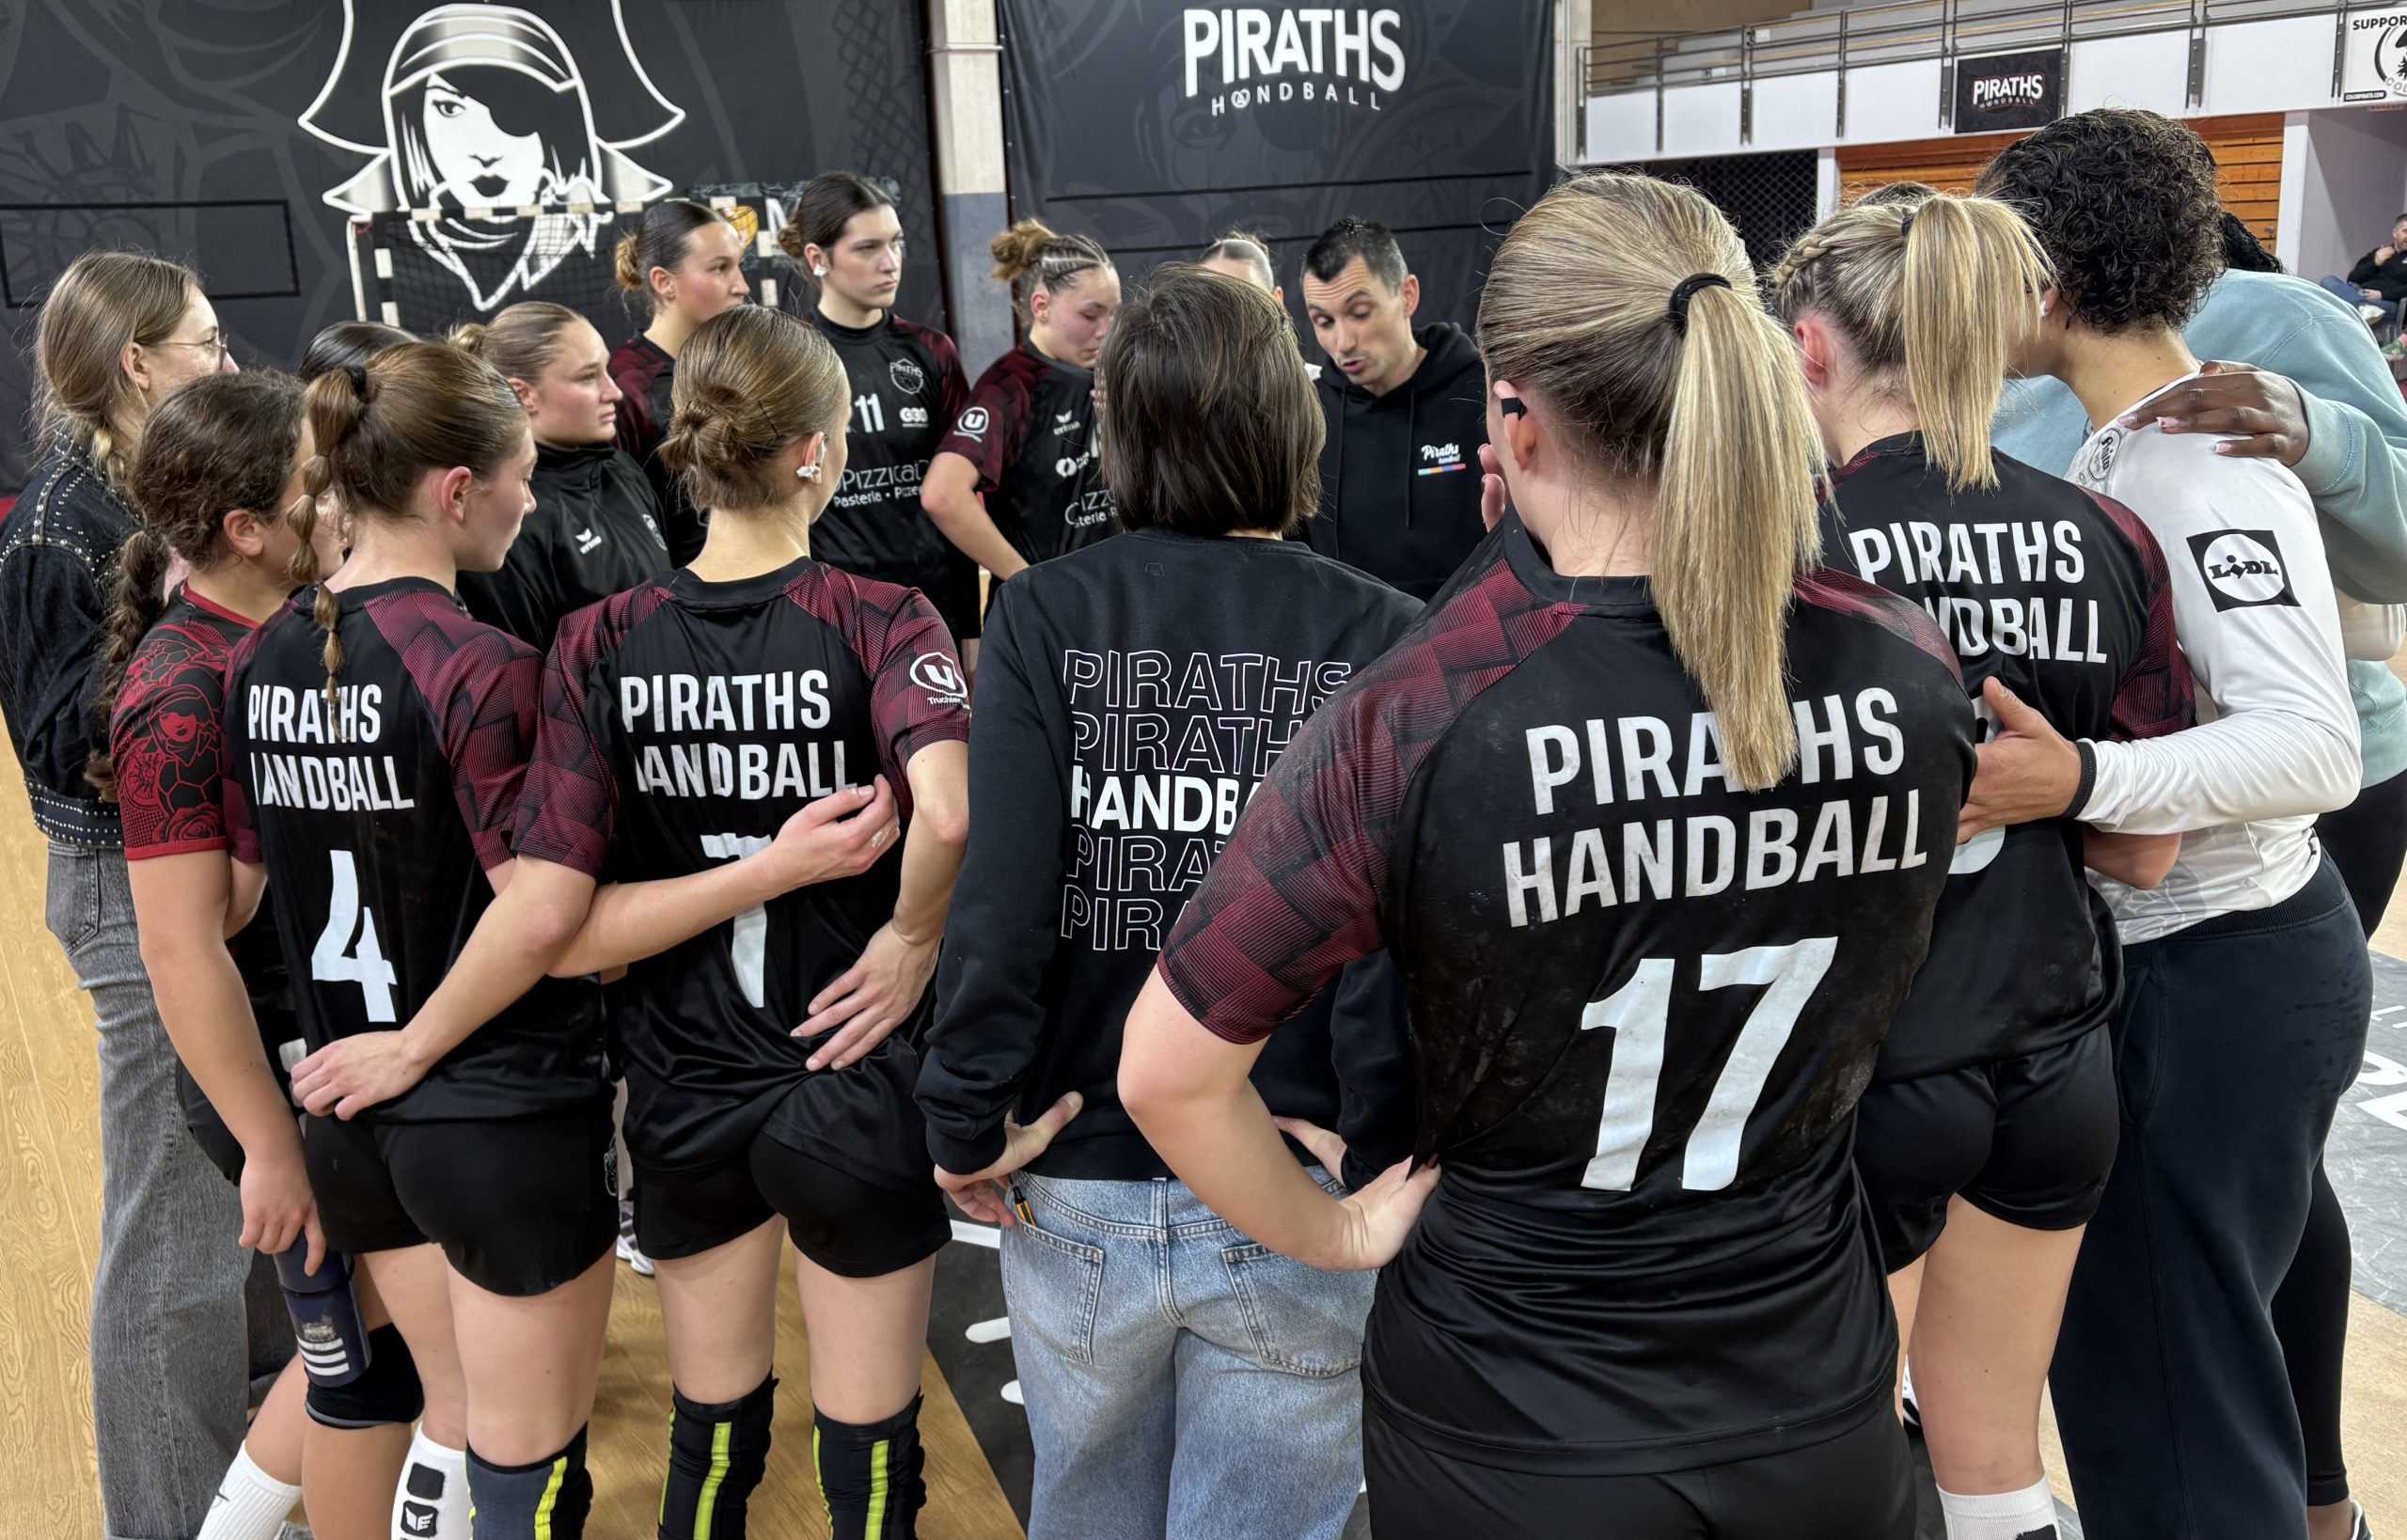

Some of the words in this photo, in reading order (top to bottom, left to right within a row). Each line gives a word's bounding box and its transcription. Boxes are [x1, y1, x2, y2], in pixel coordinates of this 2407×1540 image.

[1183, 8, 1406, 97] PIRATHS
[1973, 74, 2044, 105] PIRATHS
[854, 393, 886, 432] 11
[1848, 520, 2085, 586] PIRATHS
[1924, 595, 2108, 664] NDBALL
[248, 684, 382, 744] PIRATHS
[620, 669, 831, 732] PIRATHS
[1070, 711, 1303, 776] PIRATH
[1525, 686, 1905, 815] PIRAHS
[1070, 765, 1262, 835] HANDB
[1066, 824, 1230, 892] PIRA
[1502, 788, 1927, 928] HANDBALL
[310, 849, 398, 1022] 4
[700, 832, 774, 1009] 7
[1581, 935, 1838, 1192] 17
